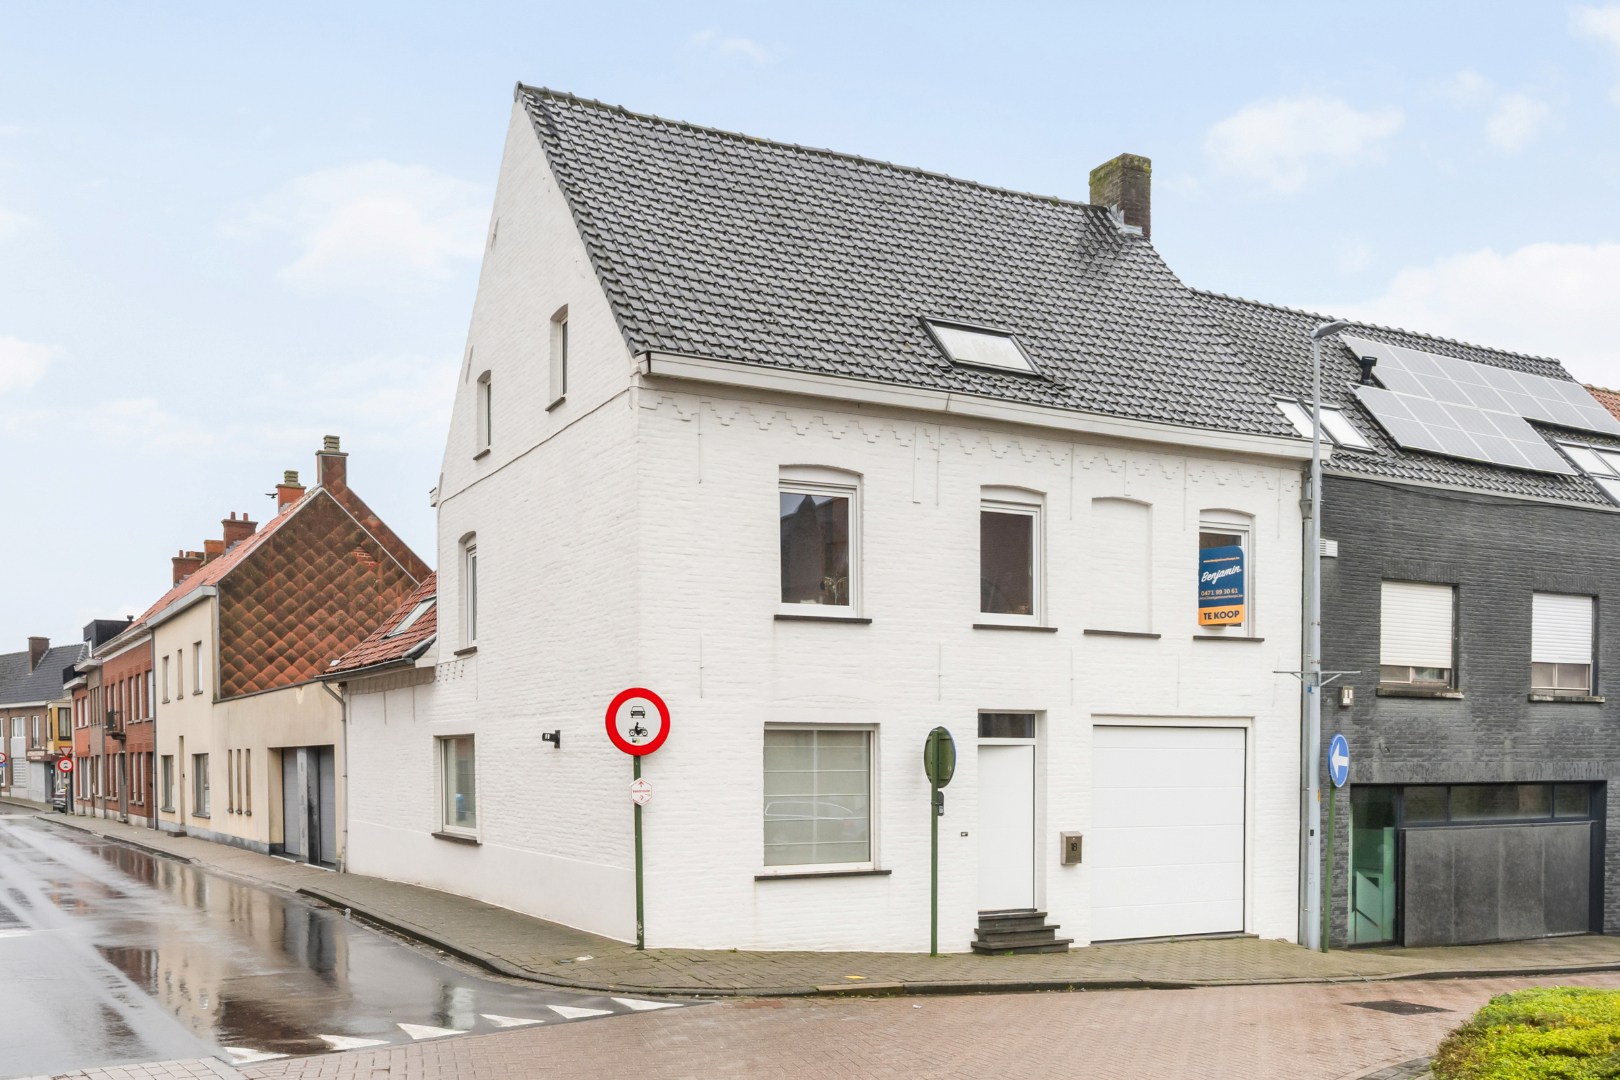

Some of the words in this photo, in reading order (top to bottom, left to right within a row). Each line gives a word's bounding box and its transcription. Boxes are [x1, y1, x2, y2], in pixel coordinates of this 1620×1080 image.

[1203, 612, 1212, 620] TE
[1214, 610, 1240, 619] KOOP
[1071, 842, 1078, 851] 18
